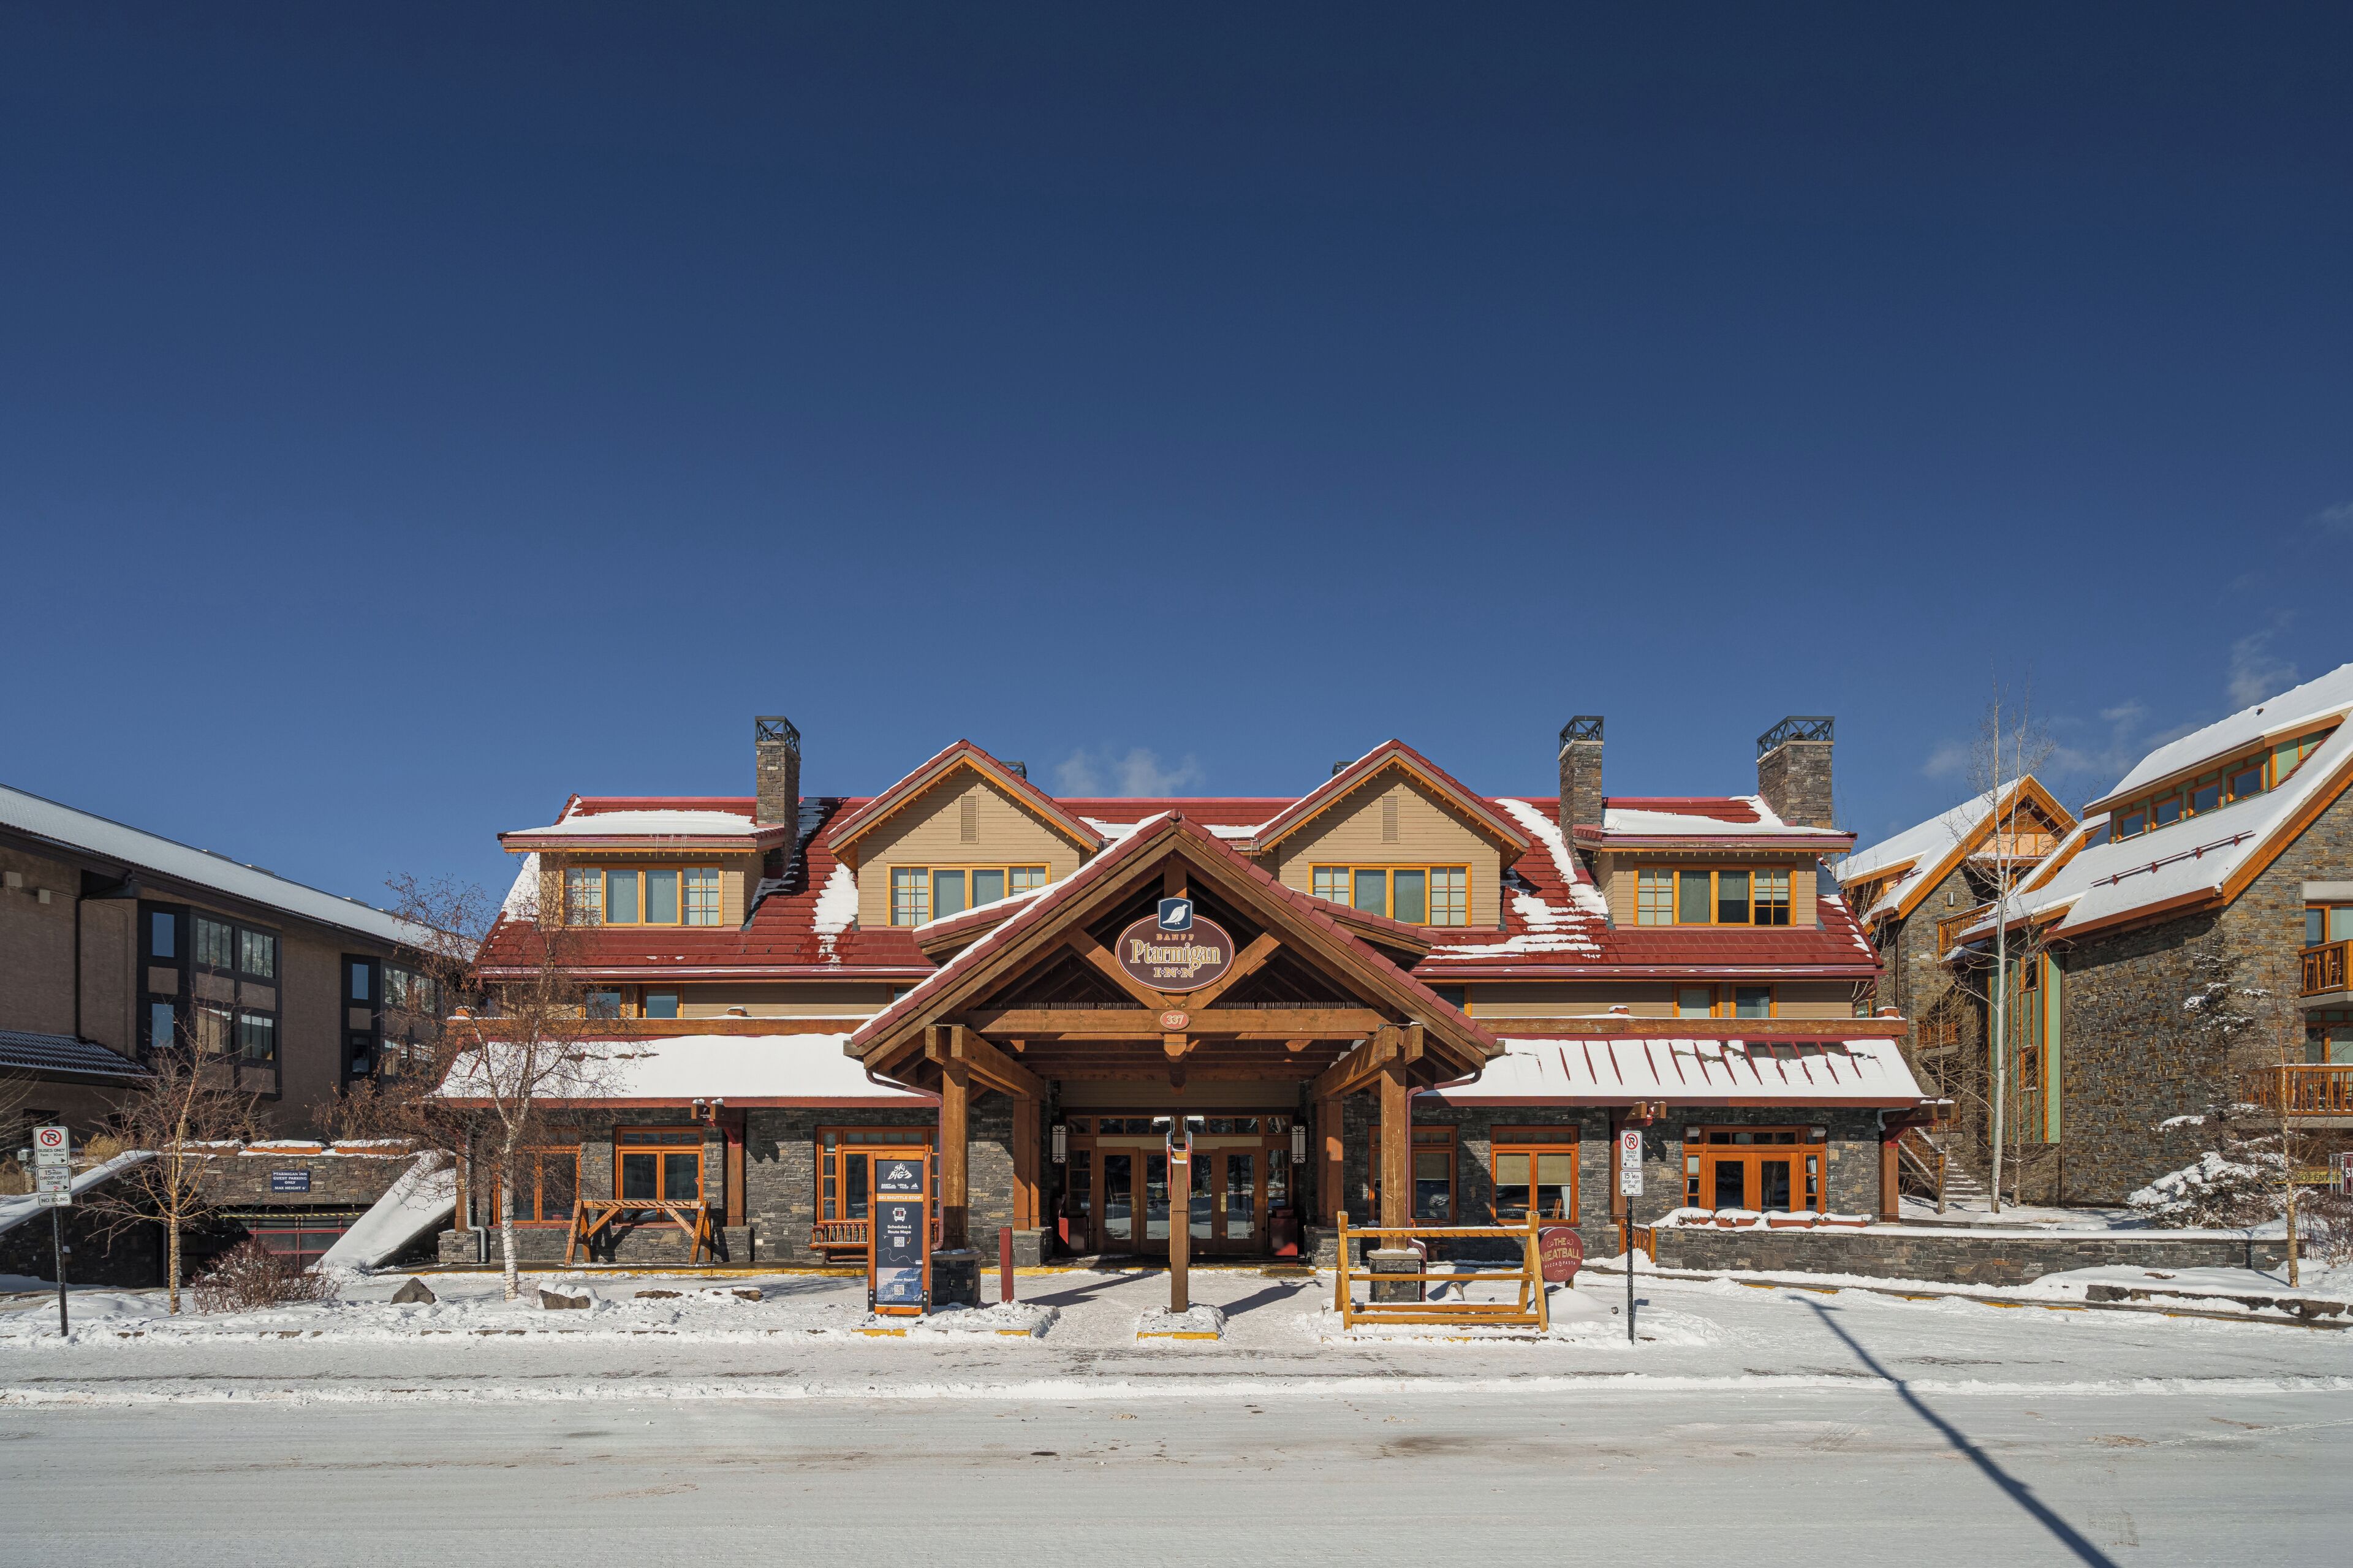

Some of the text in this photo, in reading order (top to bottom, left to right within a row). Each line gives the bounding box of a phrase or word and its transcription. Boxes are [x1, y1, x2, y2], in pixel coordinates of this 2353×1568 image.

[1130, 939, 1221, 970] Ptarmigan
[1166, 1015, 1184, 1025] 337
[1554, 1237, 1566, 1246] THE
[1540, 1248, 1581, 1262] MEATBALL
